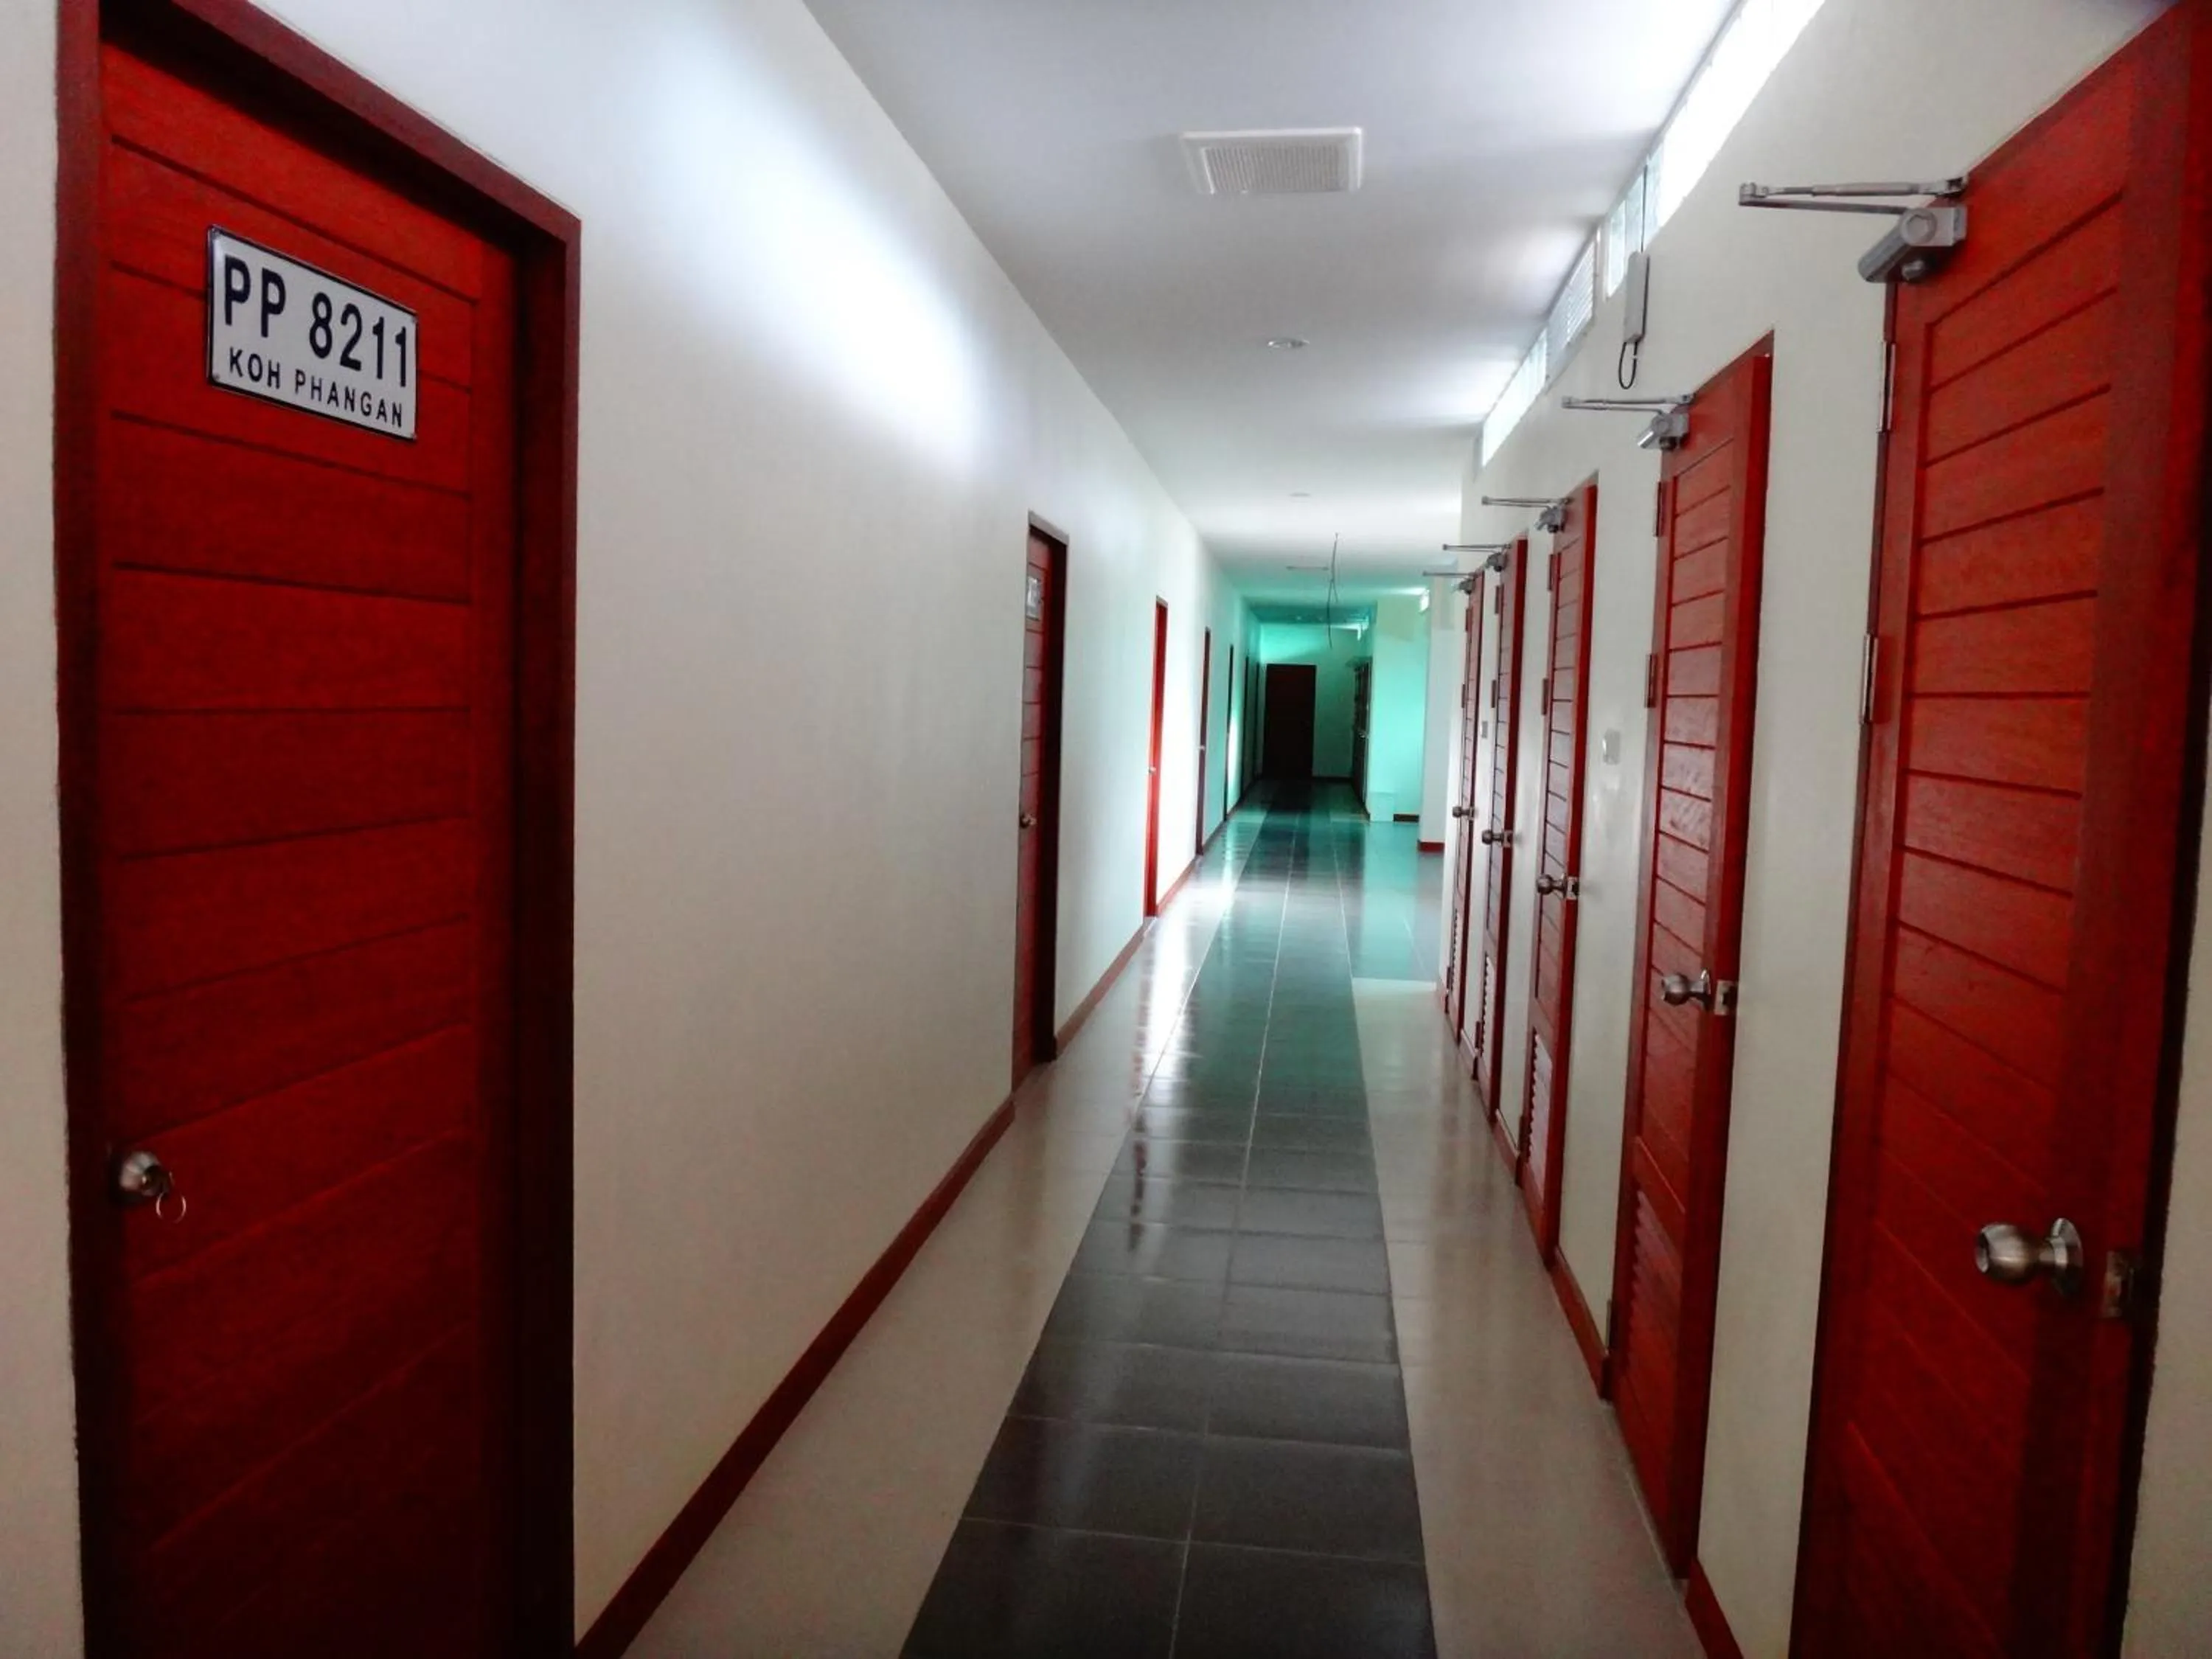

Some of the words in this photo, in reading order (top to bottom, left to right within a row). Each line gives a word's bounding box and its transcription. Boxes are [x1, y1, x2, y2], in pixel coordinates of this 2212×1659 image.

[224, 254, 286, 338] PP
[309, 291, 407, 388] 8211
[229, 347, 281, 389] KOH
[295, 369, 403, 428] PHANGAN
